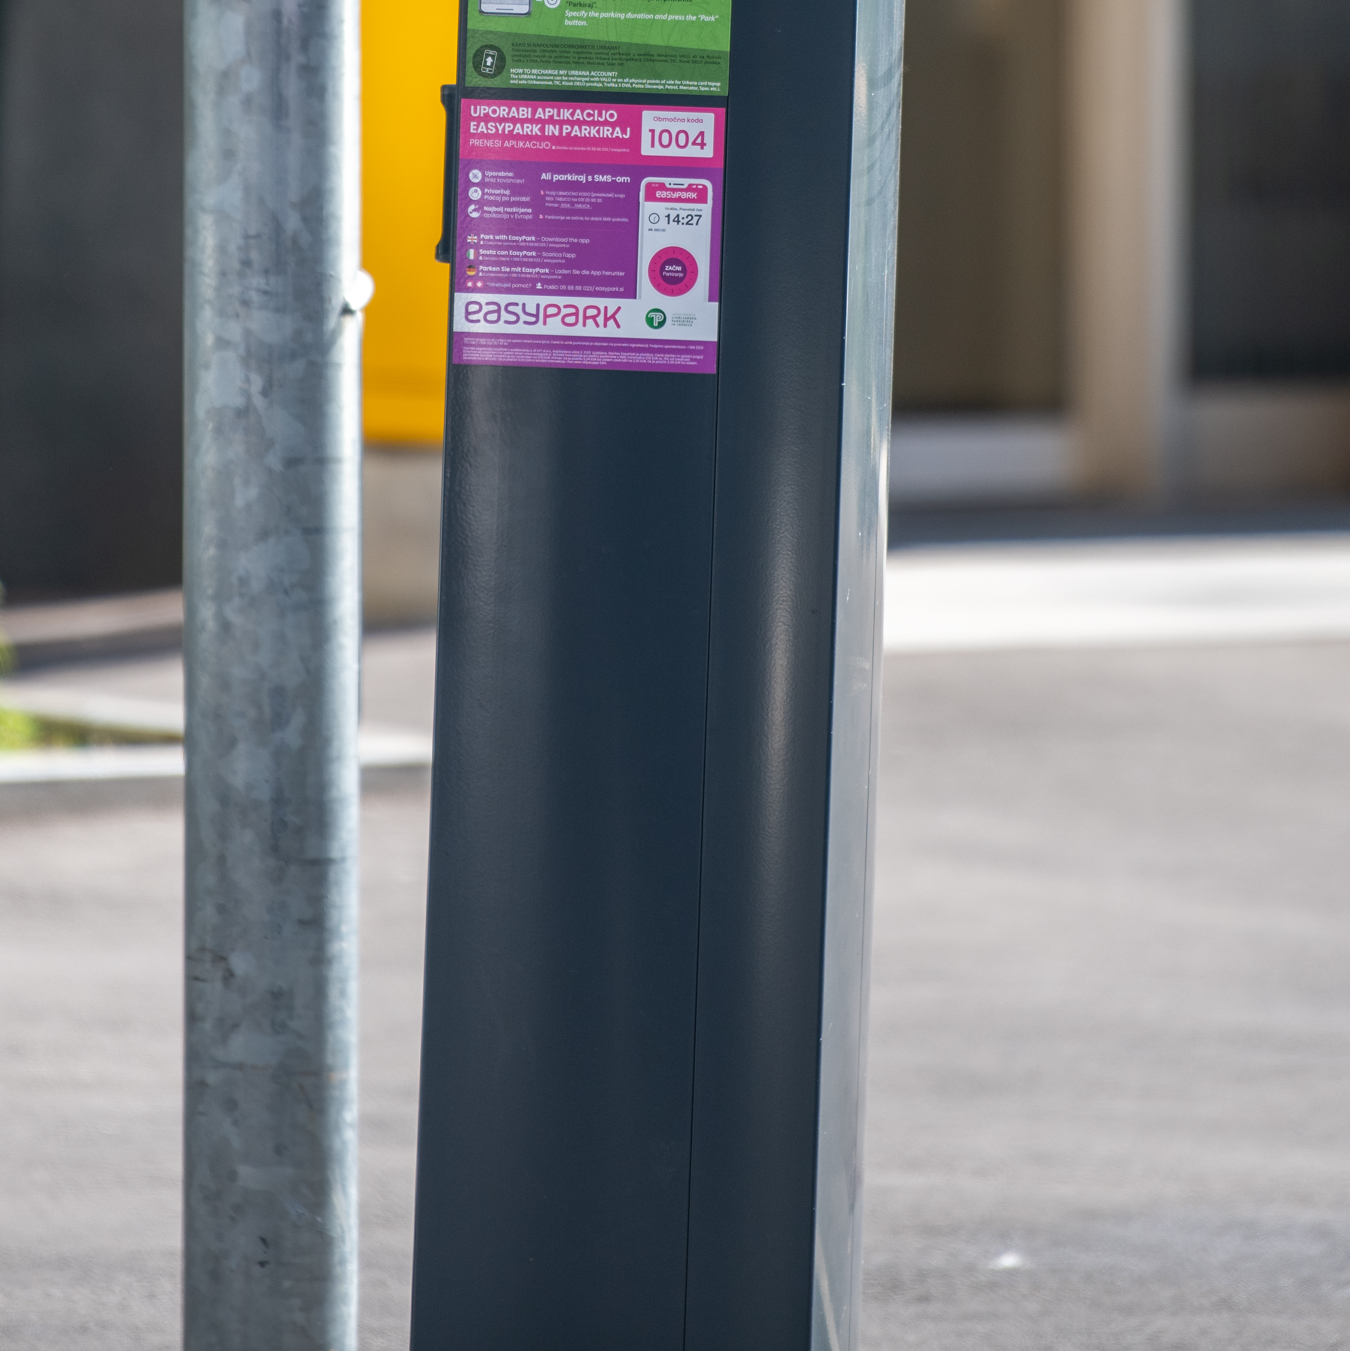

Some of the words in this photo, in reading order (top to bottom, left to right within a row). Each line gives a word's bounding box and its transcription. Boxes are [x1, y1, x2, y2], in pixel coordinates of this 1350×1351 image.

[565, 10, 587, 18] Specify
[600, 11, 625, 20] parking
[668, 13, 684, 22] press
[470, 106, 531, 119] UPORABI
[535, 108, 618, 122] APLIKACIJO
[470, 122, 541, 136] EASYPARK
[546, 124, 559, 136] IN
[563, 125, 631, 139] PARKIRAJ
[469, 139, 501, 148] PRENESI
[504, 140, 551, 150] APLIKACIJO
[649, 129, 708, 151] 1004
[553, 173, 586, 183] parkiraj
[594, 174, 631, 183] SMS-om
[665, 213, 702, 226] 14:27
